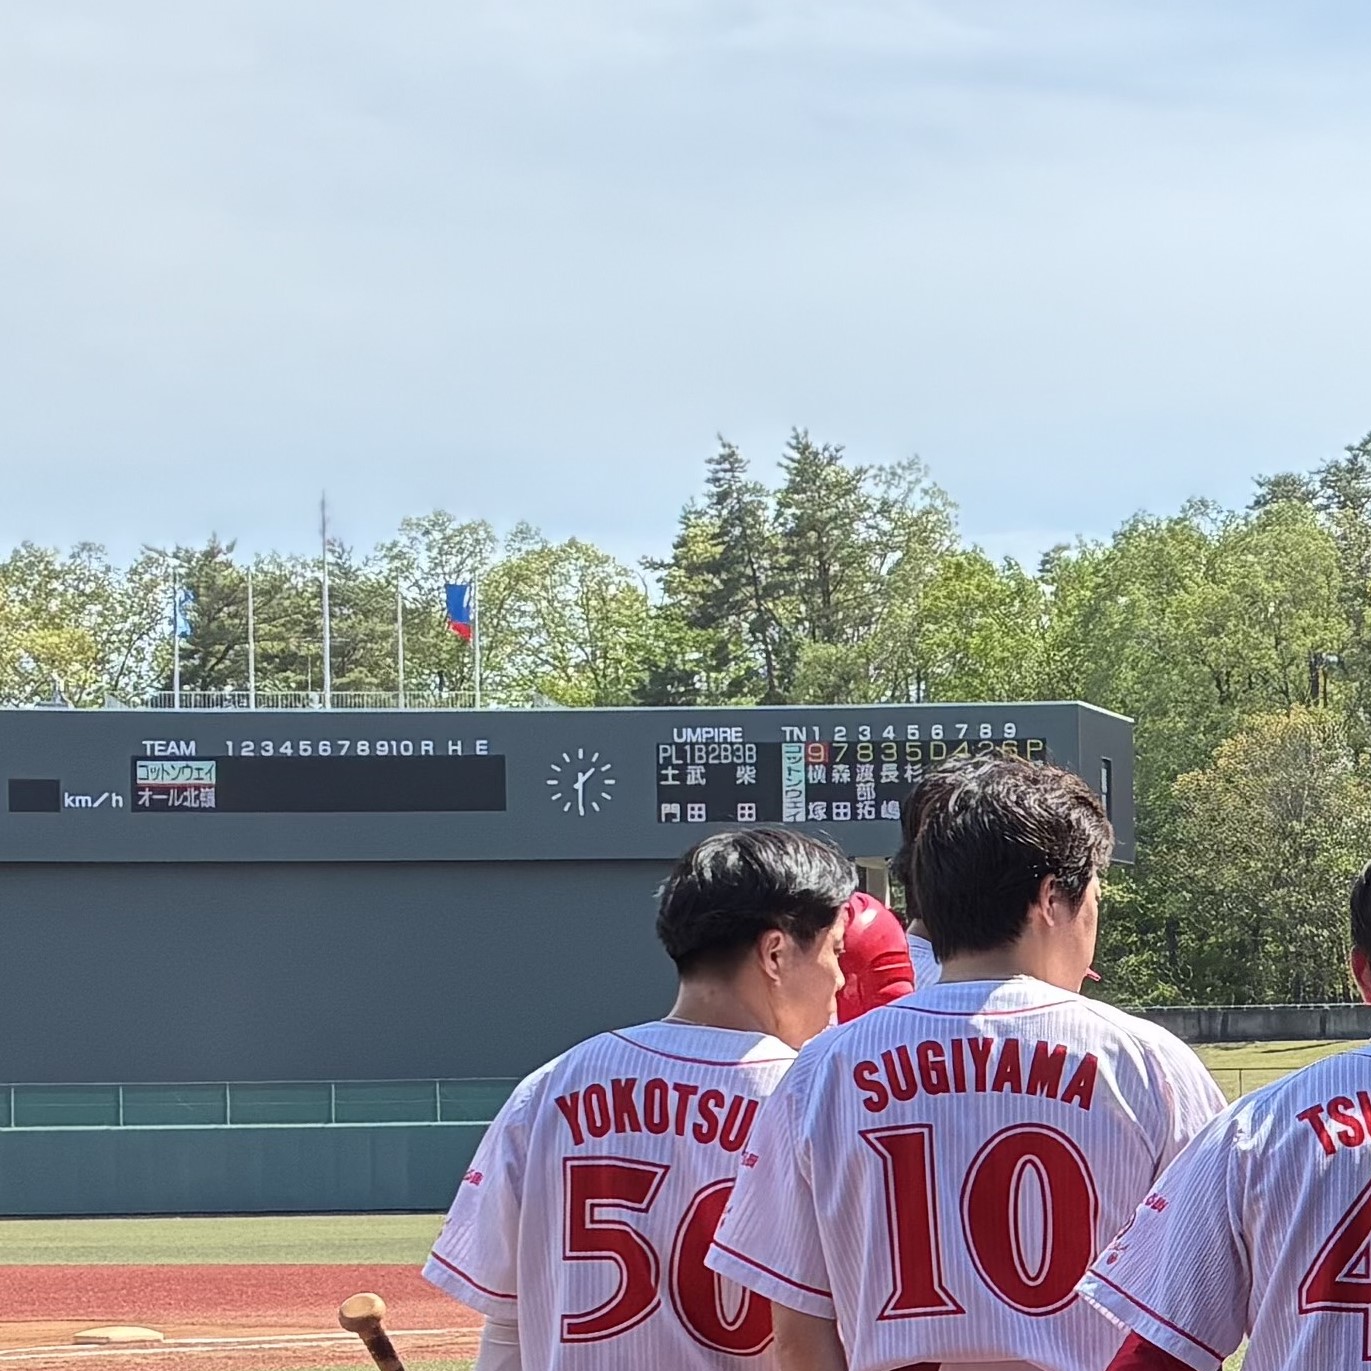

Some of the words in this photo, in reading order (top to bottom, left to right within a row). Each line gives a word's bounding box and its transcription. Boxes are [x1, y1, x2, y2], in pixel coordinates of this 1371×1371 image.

[673, 727, 743, 742] UMPIRE
[812, 726, 820, 742] 1
[833, 726, 847, 742] 2
[858, 725, 871, 741] 3
[882, 725, 896, 741] 4
[907, 724, 920, 740] 5
[931, 724, 944, 740] 6
[955, 723, 968, 739] 7
[979, 723, 992, 738] 8
[1003, 722, 1017, 738] 9
[142, 740, 196, 756] TEAM
[225, 740, 233, 756] 1
[240, 740, 255, 756] 2
[260, 740, 274, 756] 3
[279, 740, 294, 756] 4
[299, 740, 312, 756] 5
[318, 740, 332, 756] 6
[337, 740, 351, 756] 7
[356, 740, 370, 756] 8
[375, 740, 389, 756] 9
[390, 740, 414, 756] 10
[420, 740, 434, 756] R
[447, 740, 462, 756] H
[475, 739, 488, 755] E
[807, 742, 825, 763] 9
[832, 742, 849, 763] 7
[856, 742, 874, 763] 8
[880, 742, 898, 762] 3
[905, 741, 922, 762] 5
[64, 792, 124, 808] km/h
[853, 1036, 1099, 1112] SUGIYAMA
[859, 1121, 1099, 1322] 10
